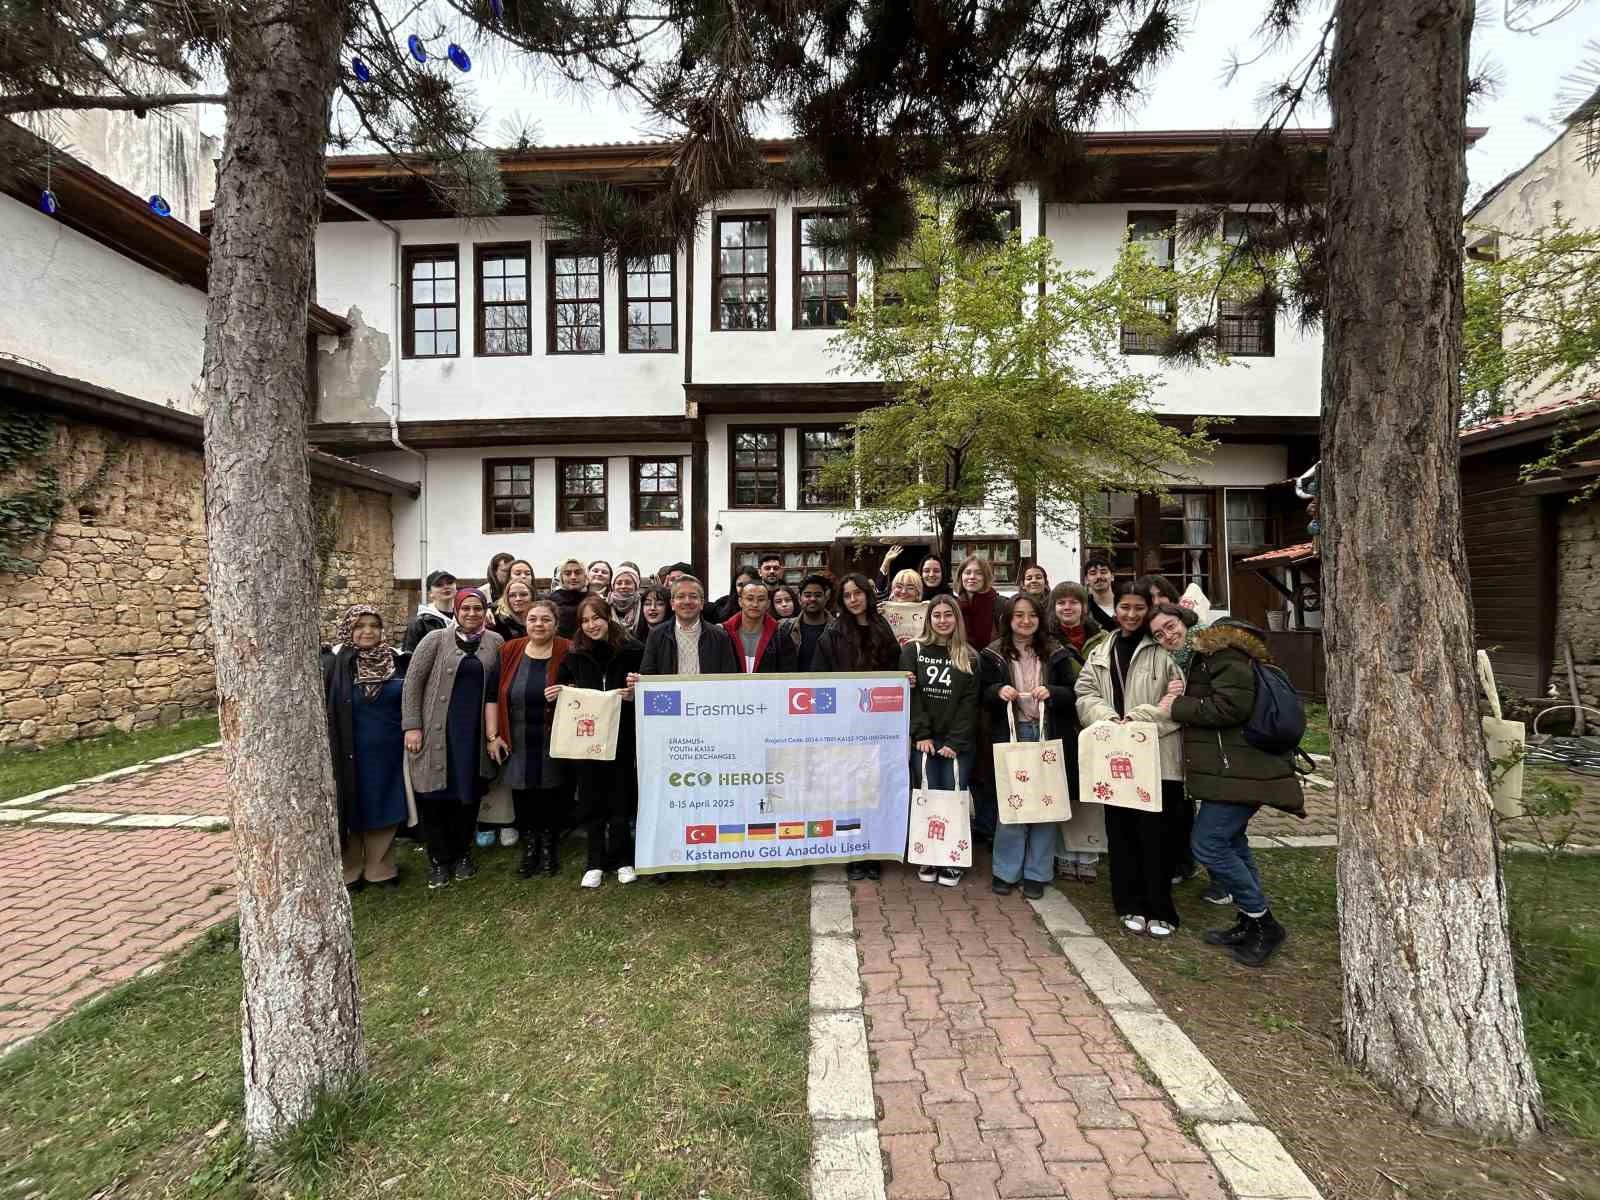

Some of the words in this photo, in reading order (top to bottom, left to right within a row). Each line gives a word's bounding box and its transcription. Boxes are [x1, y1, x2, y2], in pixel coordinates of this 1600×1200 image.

[926, 666, 952, 687] 94
[685, 702, 768, 716] Erasmus+
[669, 745, 693, 753] YOUTH
[718, 771, 785, 786] HEROES
[669, 800, 686, 809] 8-15
[688, 799, 710, 810] April
[712, 799, 735, 808] 2025
[685, 847, 755, 862] Kastamonu
[758, 845, 782, 858] Göl
[785, 844, 837, 857] Anadolu
[840, 840, 871, 854] Lisesi
